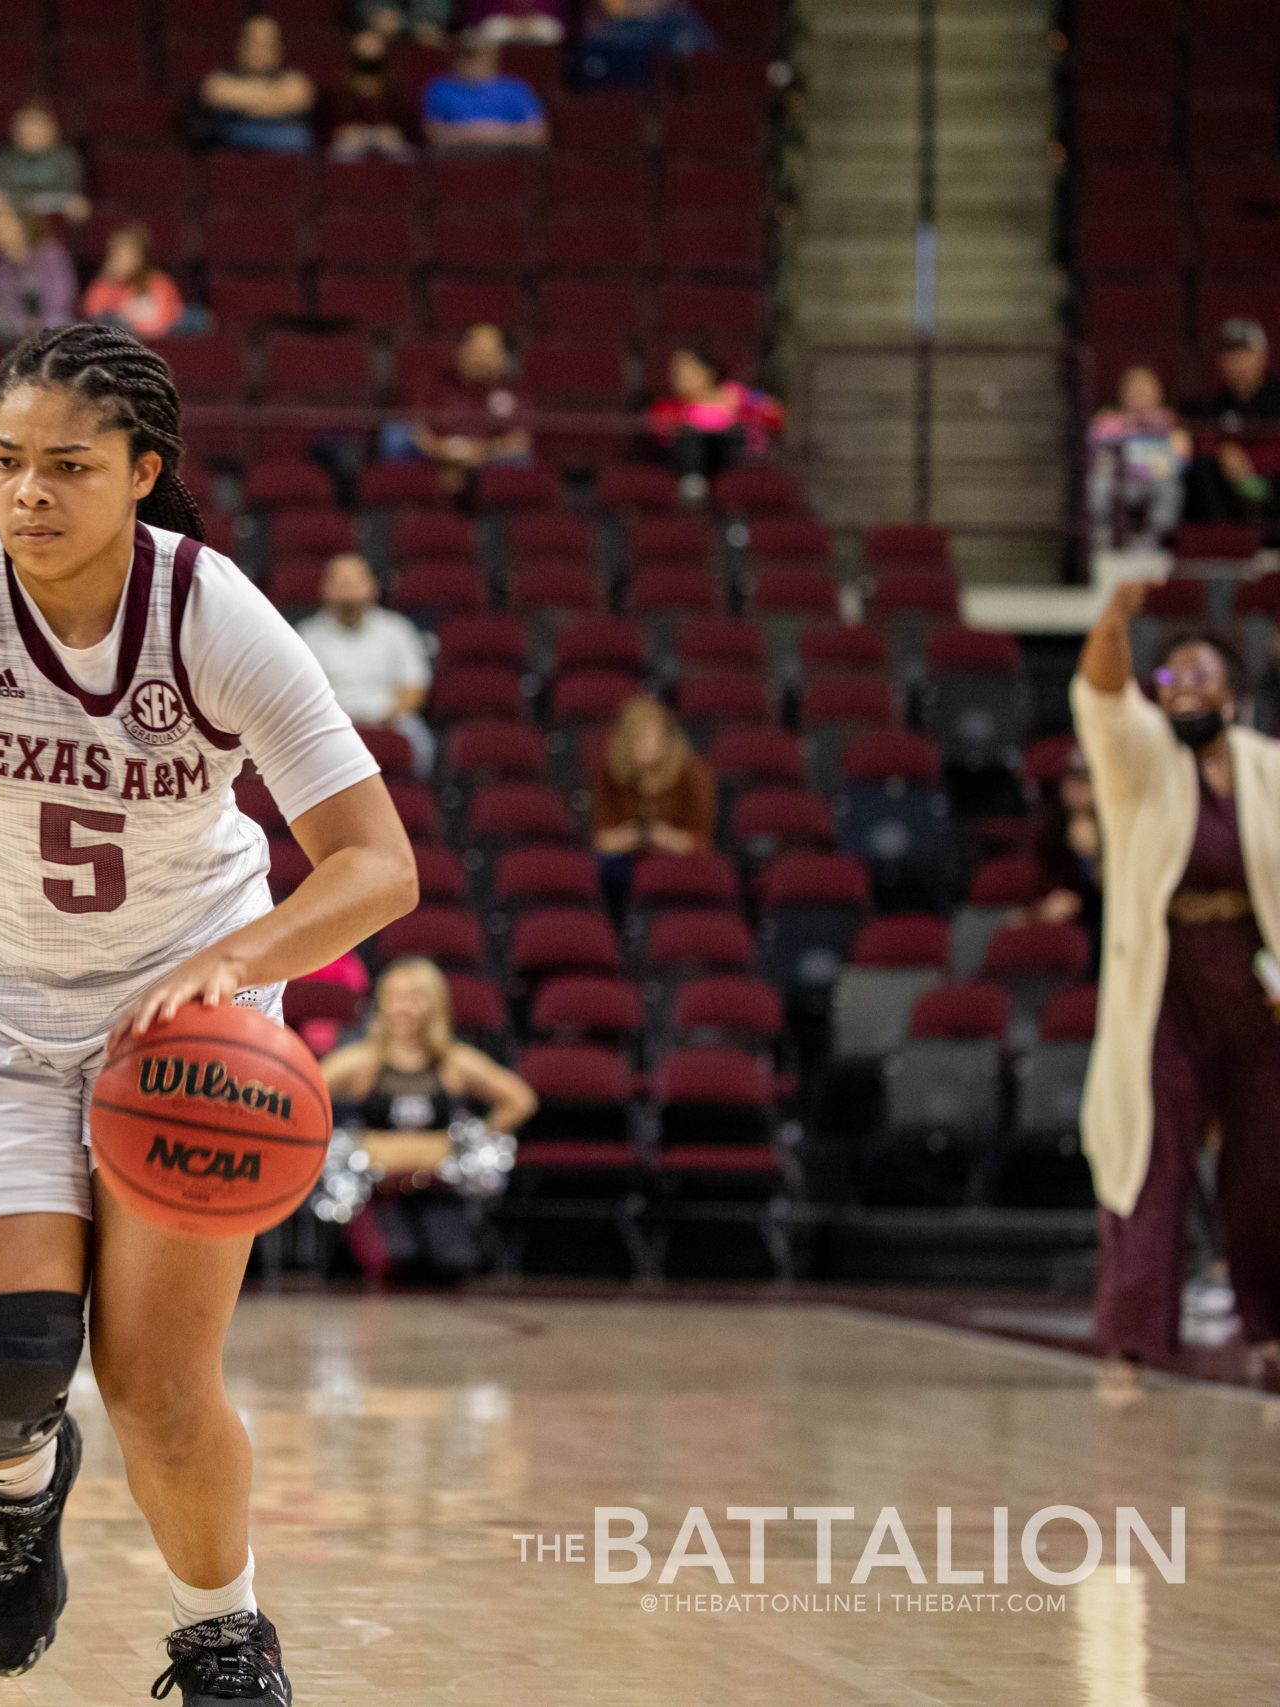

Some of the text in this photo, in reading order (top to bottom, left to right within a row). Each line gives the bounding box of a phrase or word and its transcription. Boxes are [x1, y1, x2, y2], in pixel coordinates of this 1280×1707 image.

[135, 684, 179, 729] SEC
[130, 725, 186, 744] GRADUATE
[121, 748, 211, 801] A&M
[40, 801, 127, 914] 5
[138, 1055, 293, 1121] Wilson
[146, 1134, 262, 1182] NCAA
